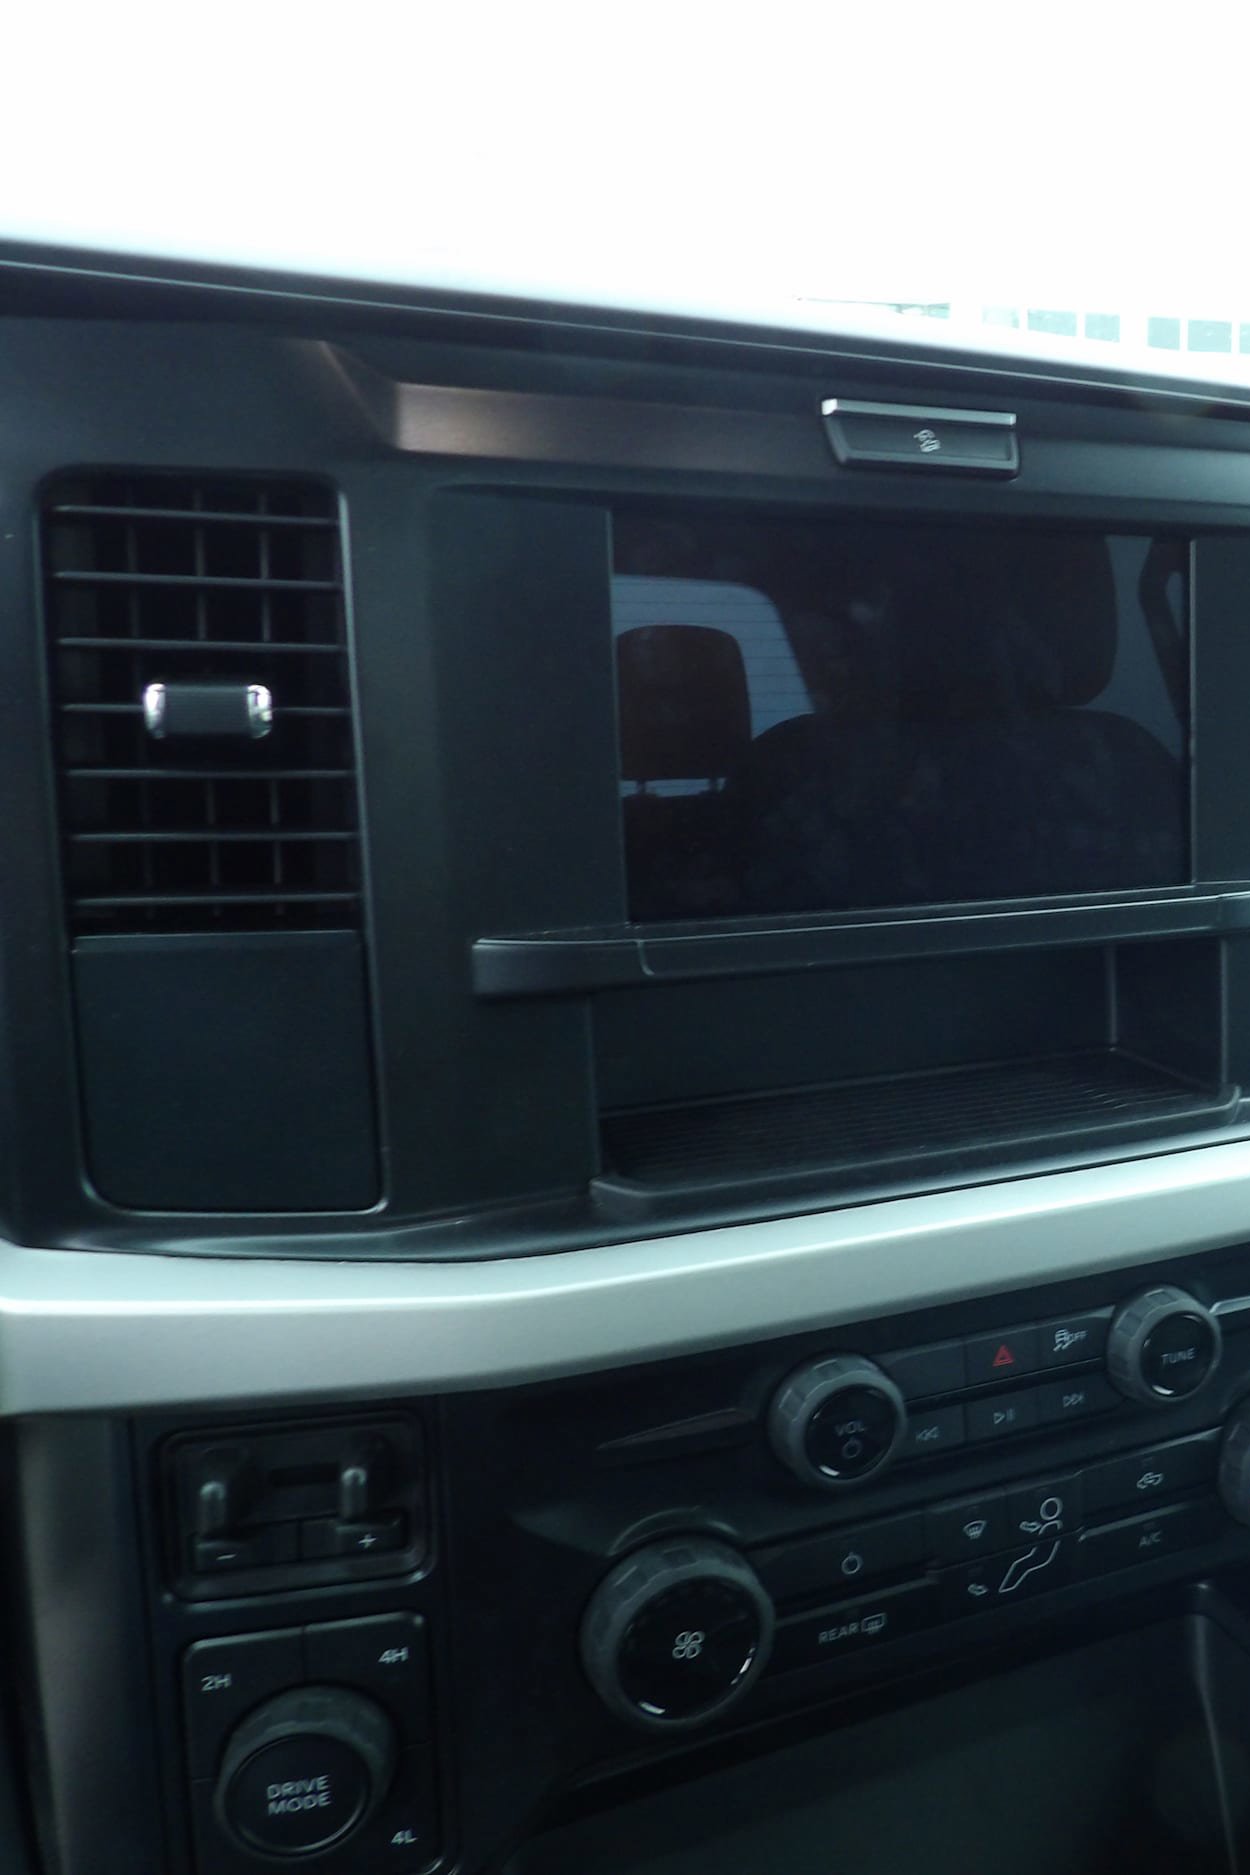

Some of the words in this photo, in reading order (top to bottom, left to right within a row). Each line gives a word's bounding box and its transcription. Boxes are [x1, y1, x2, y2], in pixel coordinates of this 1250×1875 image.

[1160, 1347, 1195, 1366] TUNE
[834, 1421, 867, 1437] VOL
[1138, 1530, 1162, 1549] A/C
[818, 1621, 860, 1645] REAR
[378, 1646, 409, 1664] 4H
[200, 1673, 232, 1692] 2H
[266, 1774, 331, 1801] DRIVE
[267, 1791, 332, 1816] MODE
[390, 1829, 418, 1846] 4L
